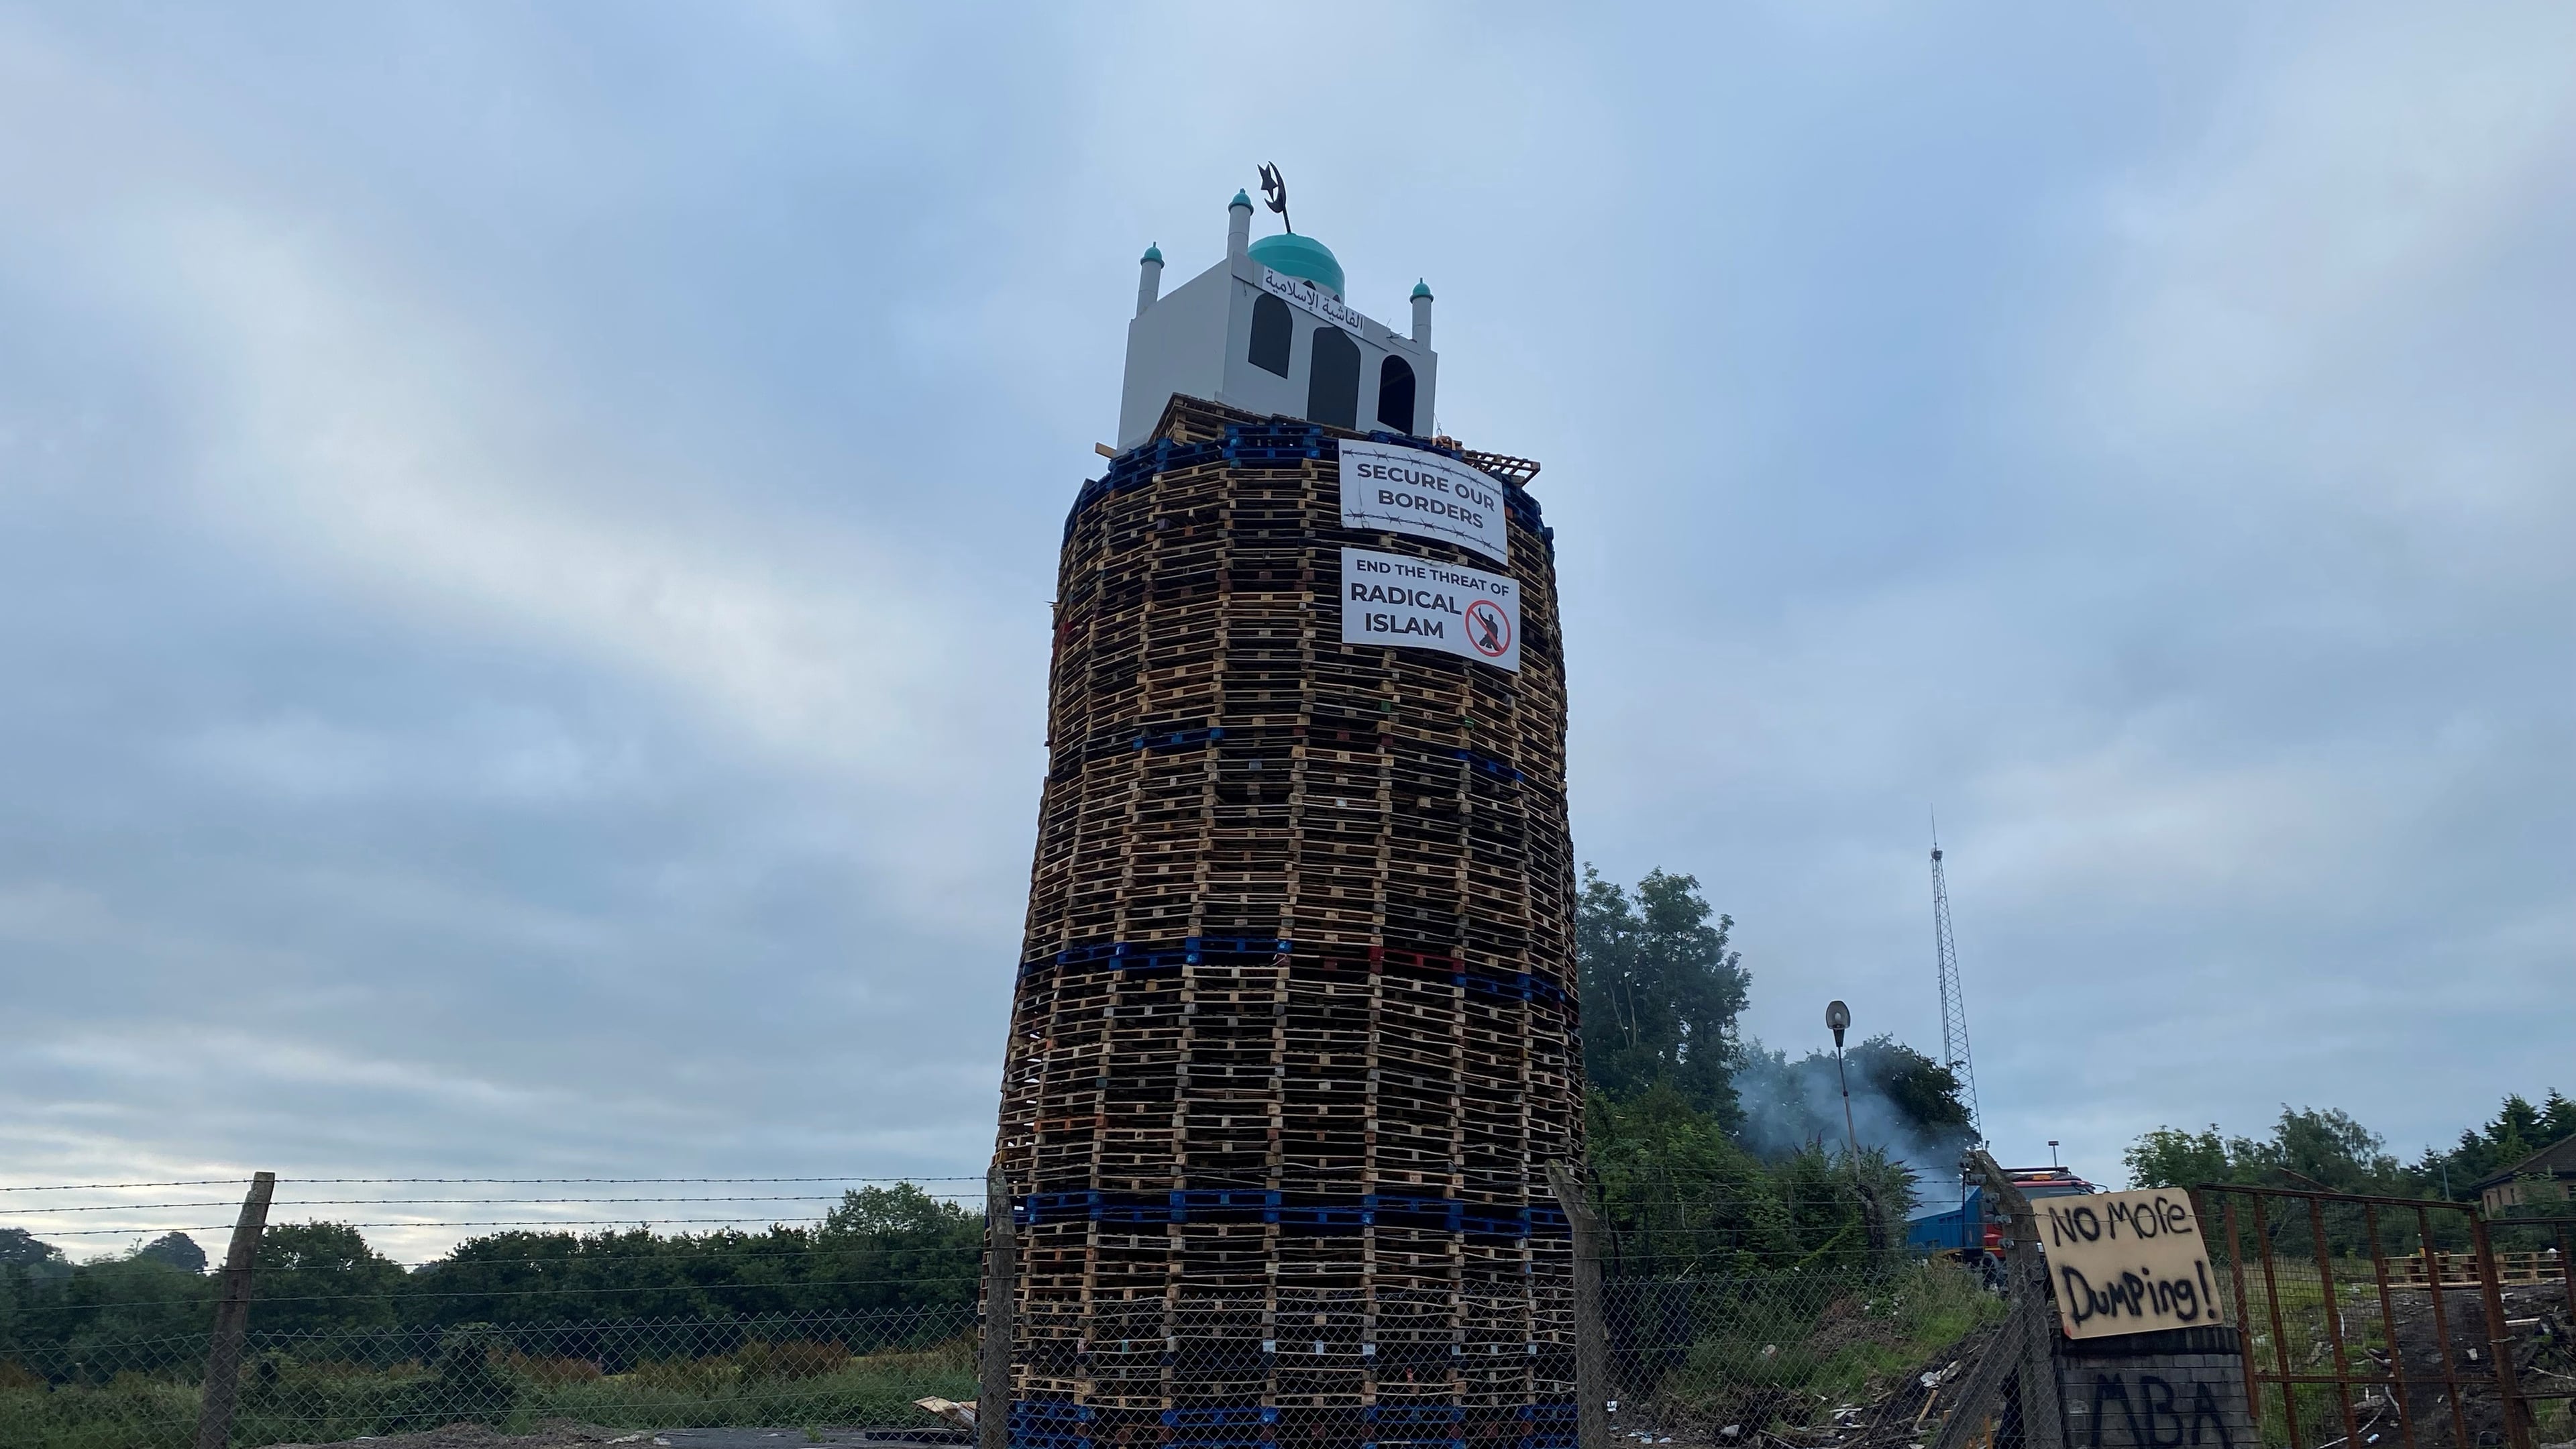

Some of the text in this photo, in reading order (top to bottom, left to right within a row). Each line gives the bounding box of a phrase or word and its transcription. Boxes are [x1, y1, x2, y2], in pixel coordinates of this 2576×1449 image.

[1266, 269, 1363, 330] الفاشية الإسلامية
[1357, 463, 1495, 512] SECURE OUR
[1379, 489, 1484, 529] BORDERS
[1356, 559, 1509, 596] END THE THREAT OF
[1350, 582, 1462, 616] RADICAL
[1365, 612, 1444, 639] ISLAM
[2049, 1205, 2101, 1247] NO
[2090, 1373, 2235, 1449] MBA
